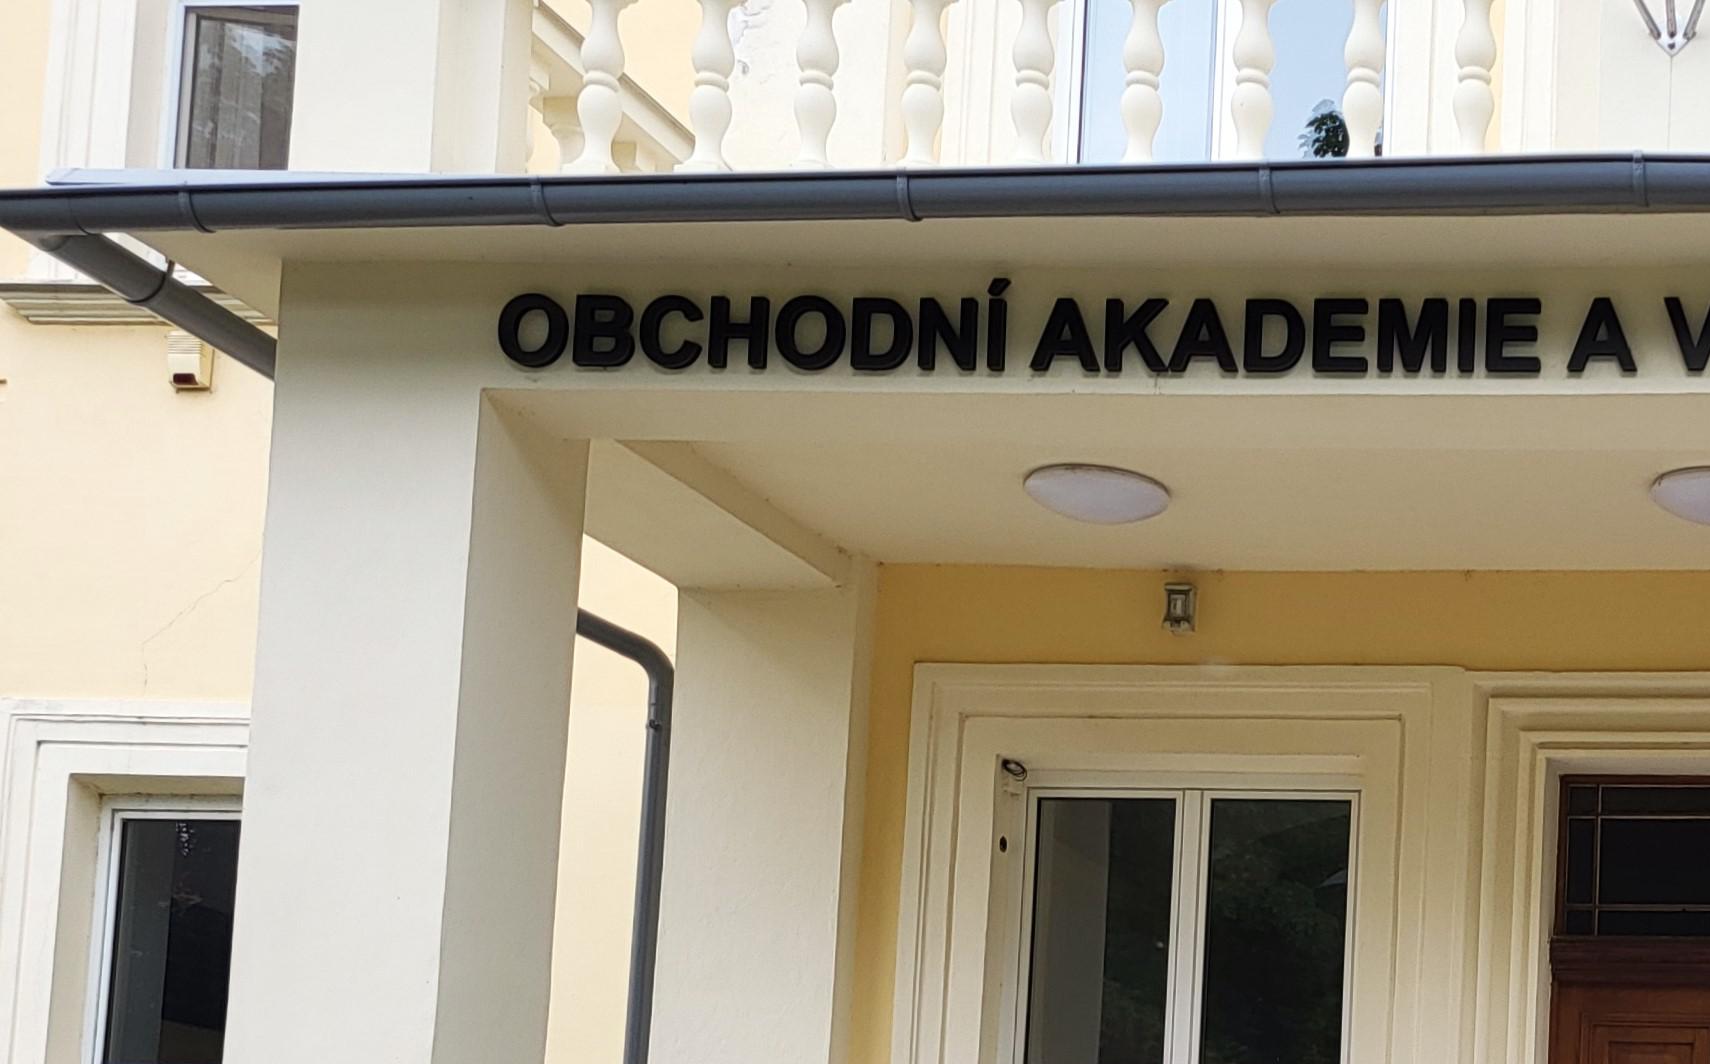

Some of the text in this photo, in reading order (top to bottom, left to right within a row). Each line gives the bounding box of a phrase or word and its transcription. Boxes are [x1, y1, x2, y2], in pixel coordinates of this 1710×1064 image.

[497, 274, 1014, 376] OBCHODNÍ
[1028, 291, 1543, 378] AKADEMIE
[1566, 295, 1638, 374] A
